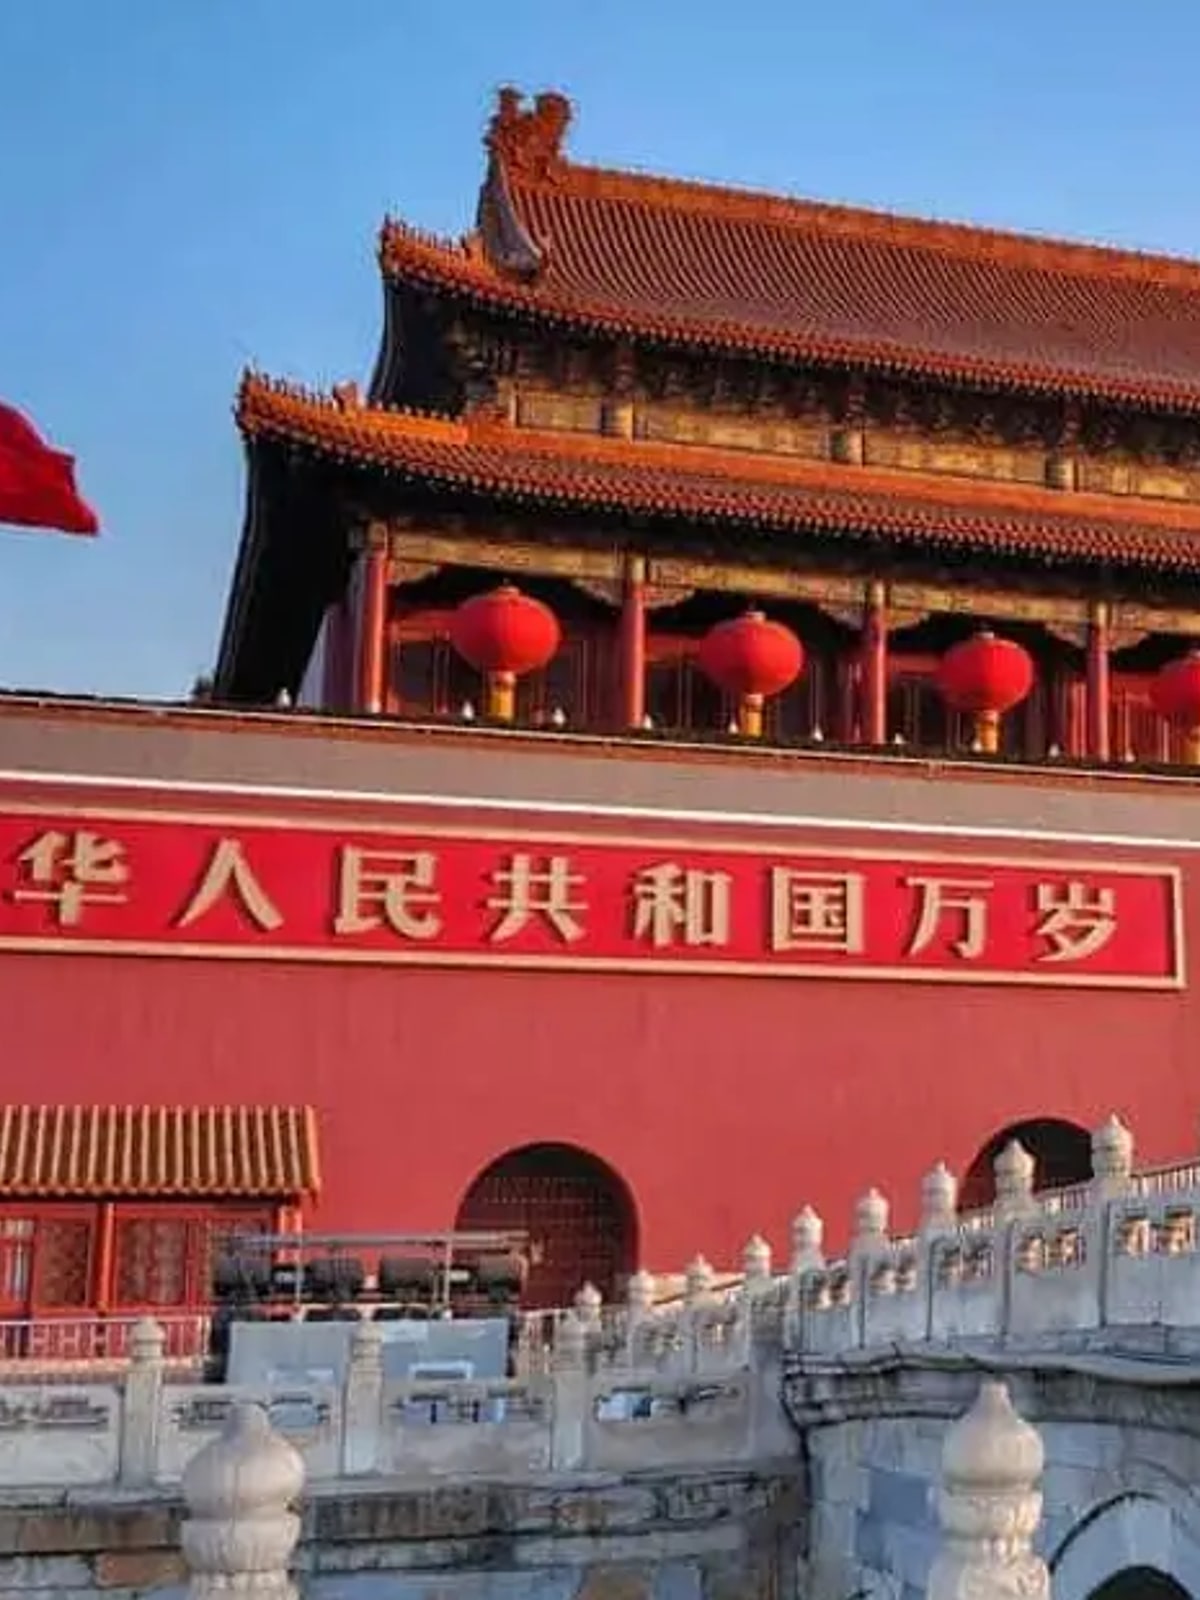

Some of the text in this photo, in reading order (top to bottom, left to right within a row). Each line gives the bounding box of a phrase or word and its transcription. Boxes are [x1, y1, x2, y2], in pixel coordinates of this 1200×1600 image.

[13, 830, 1118, 962] 华人民共和国万岁
